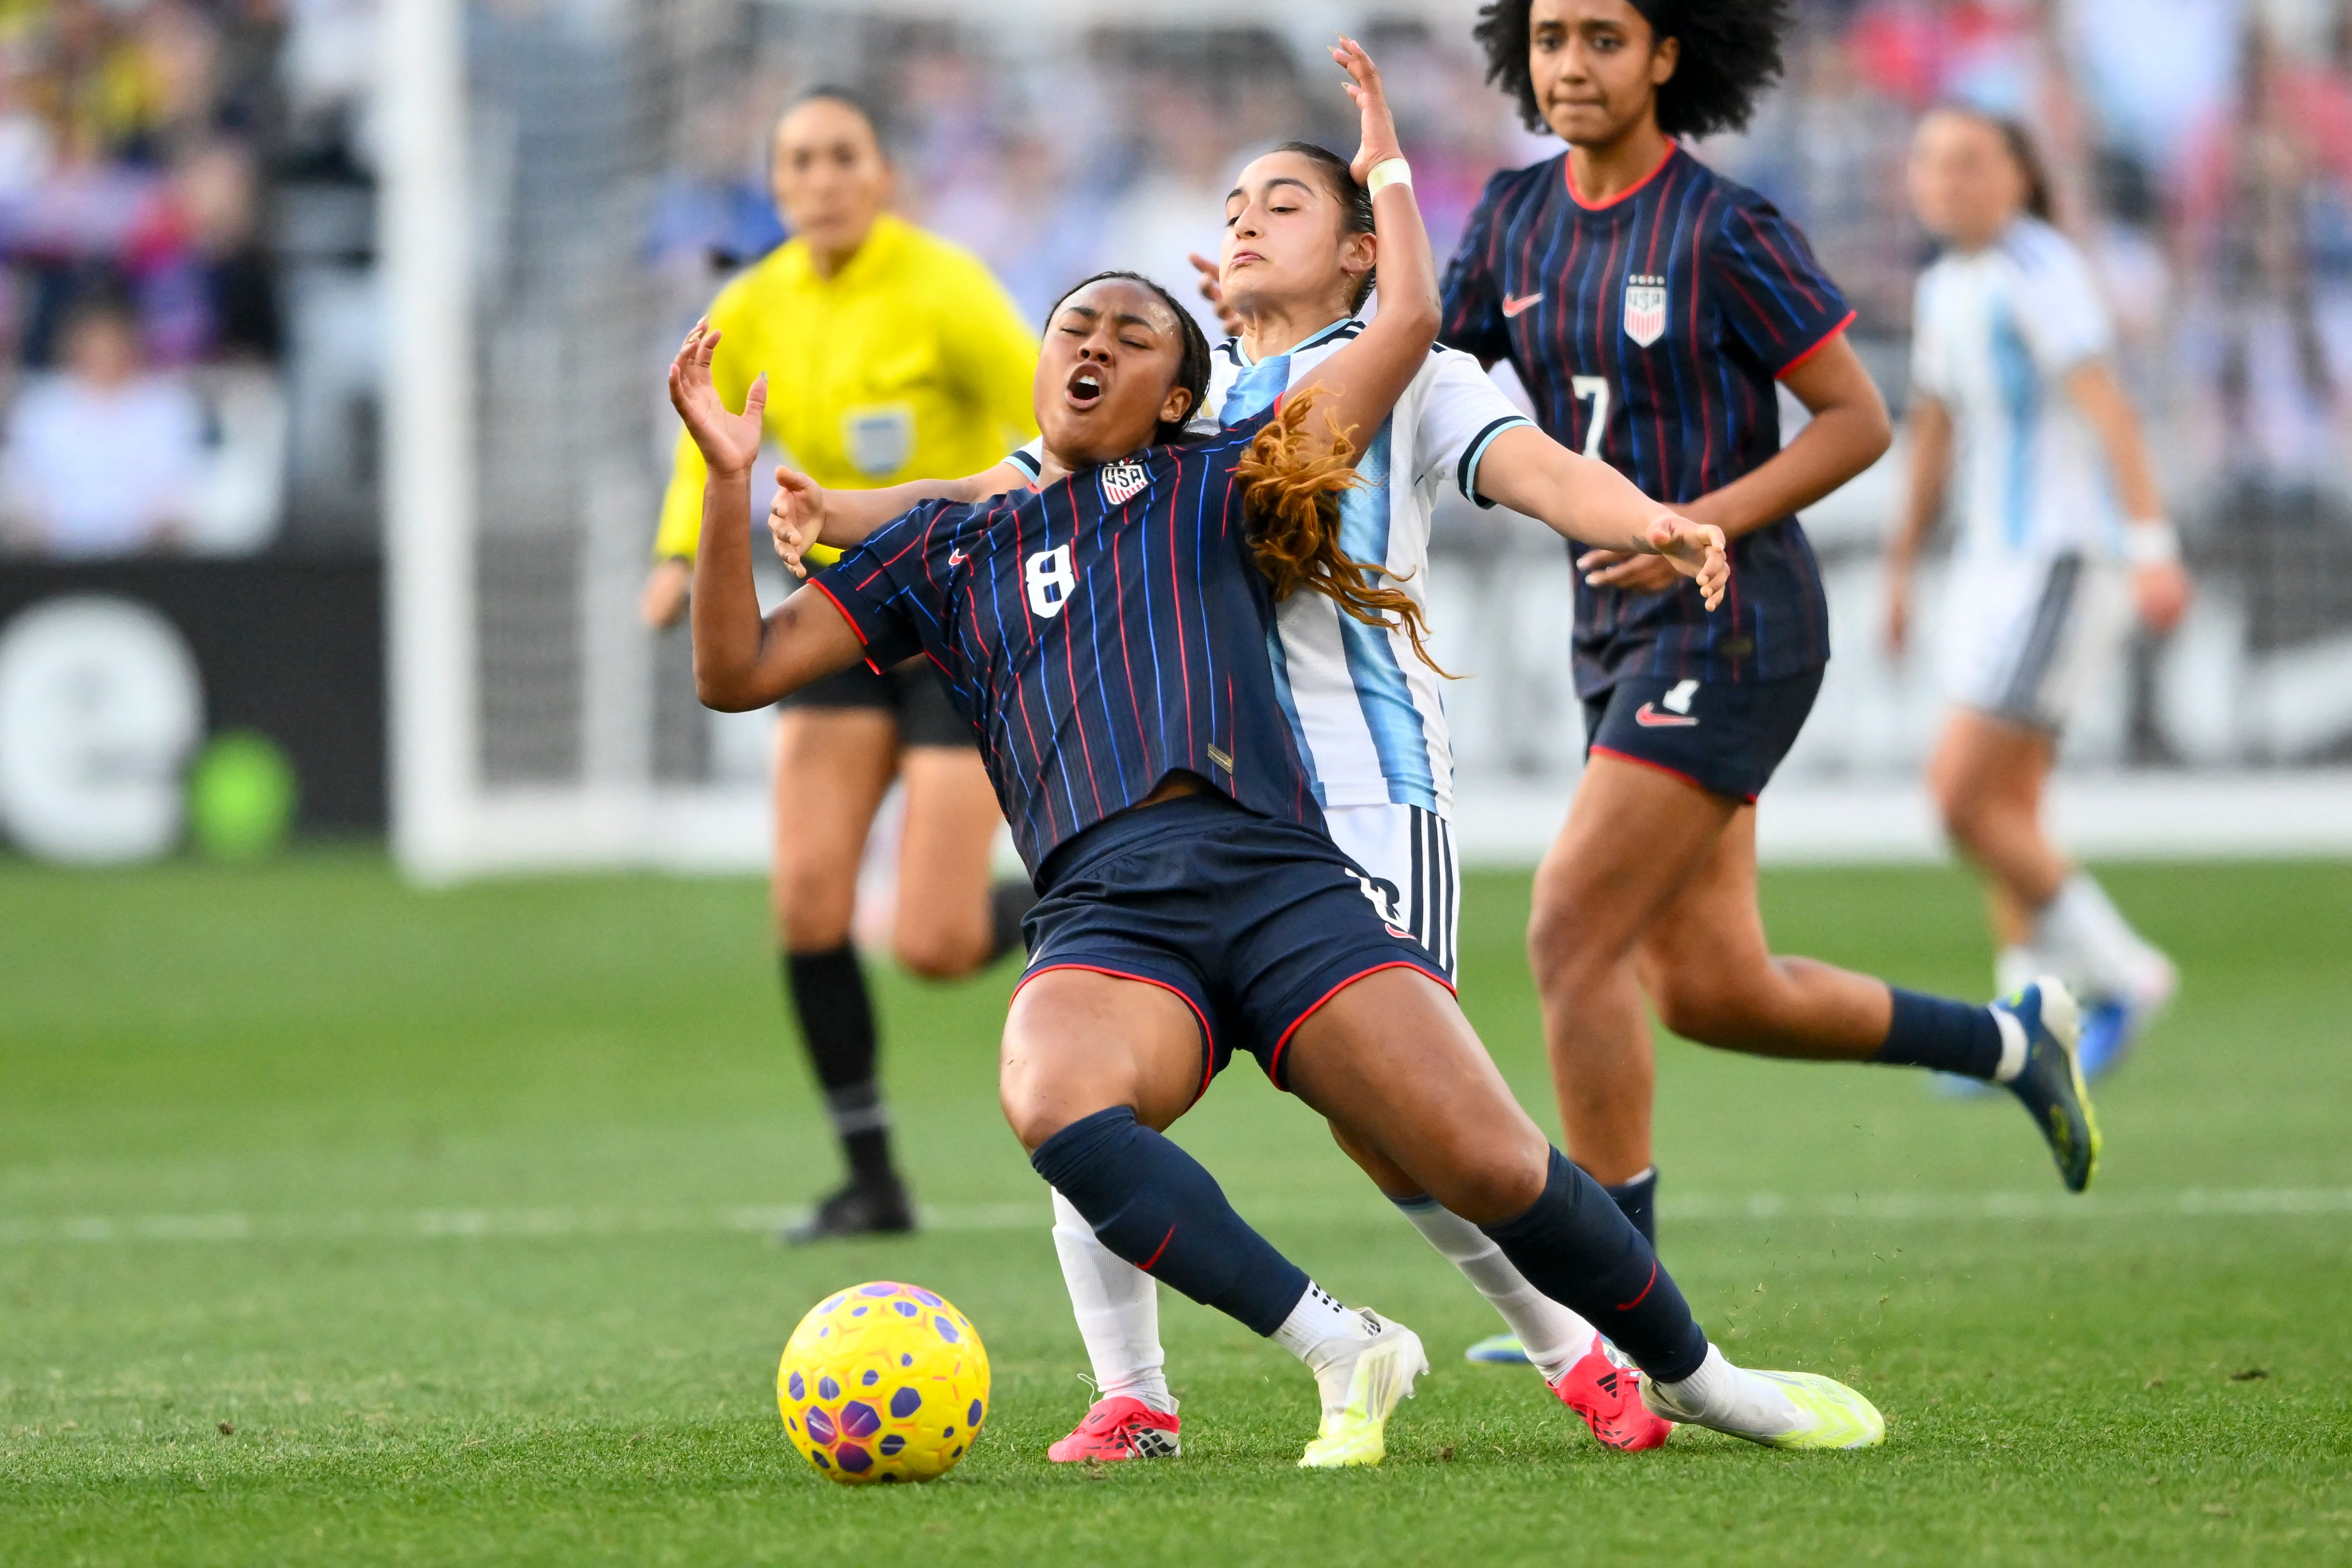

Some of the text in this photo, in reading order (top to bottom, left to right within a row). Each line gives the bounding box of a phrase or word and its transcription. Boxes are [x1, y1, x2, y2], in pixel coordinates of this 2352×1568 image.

[1571, 375, 1609, 460] 7
[1105, 468, 1141, 488] USA
[1025, 544, 1075, 618] 8
